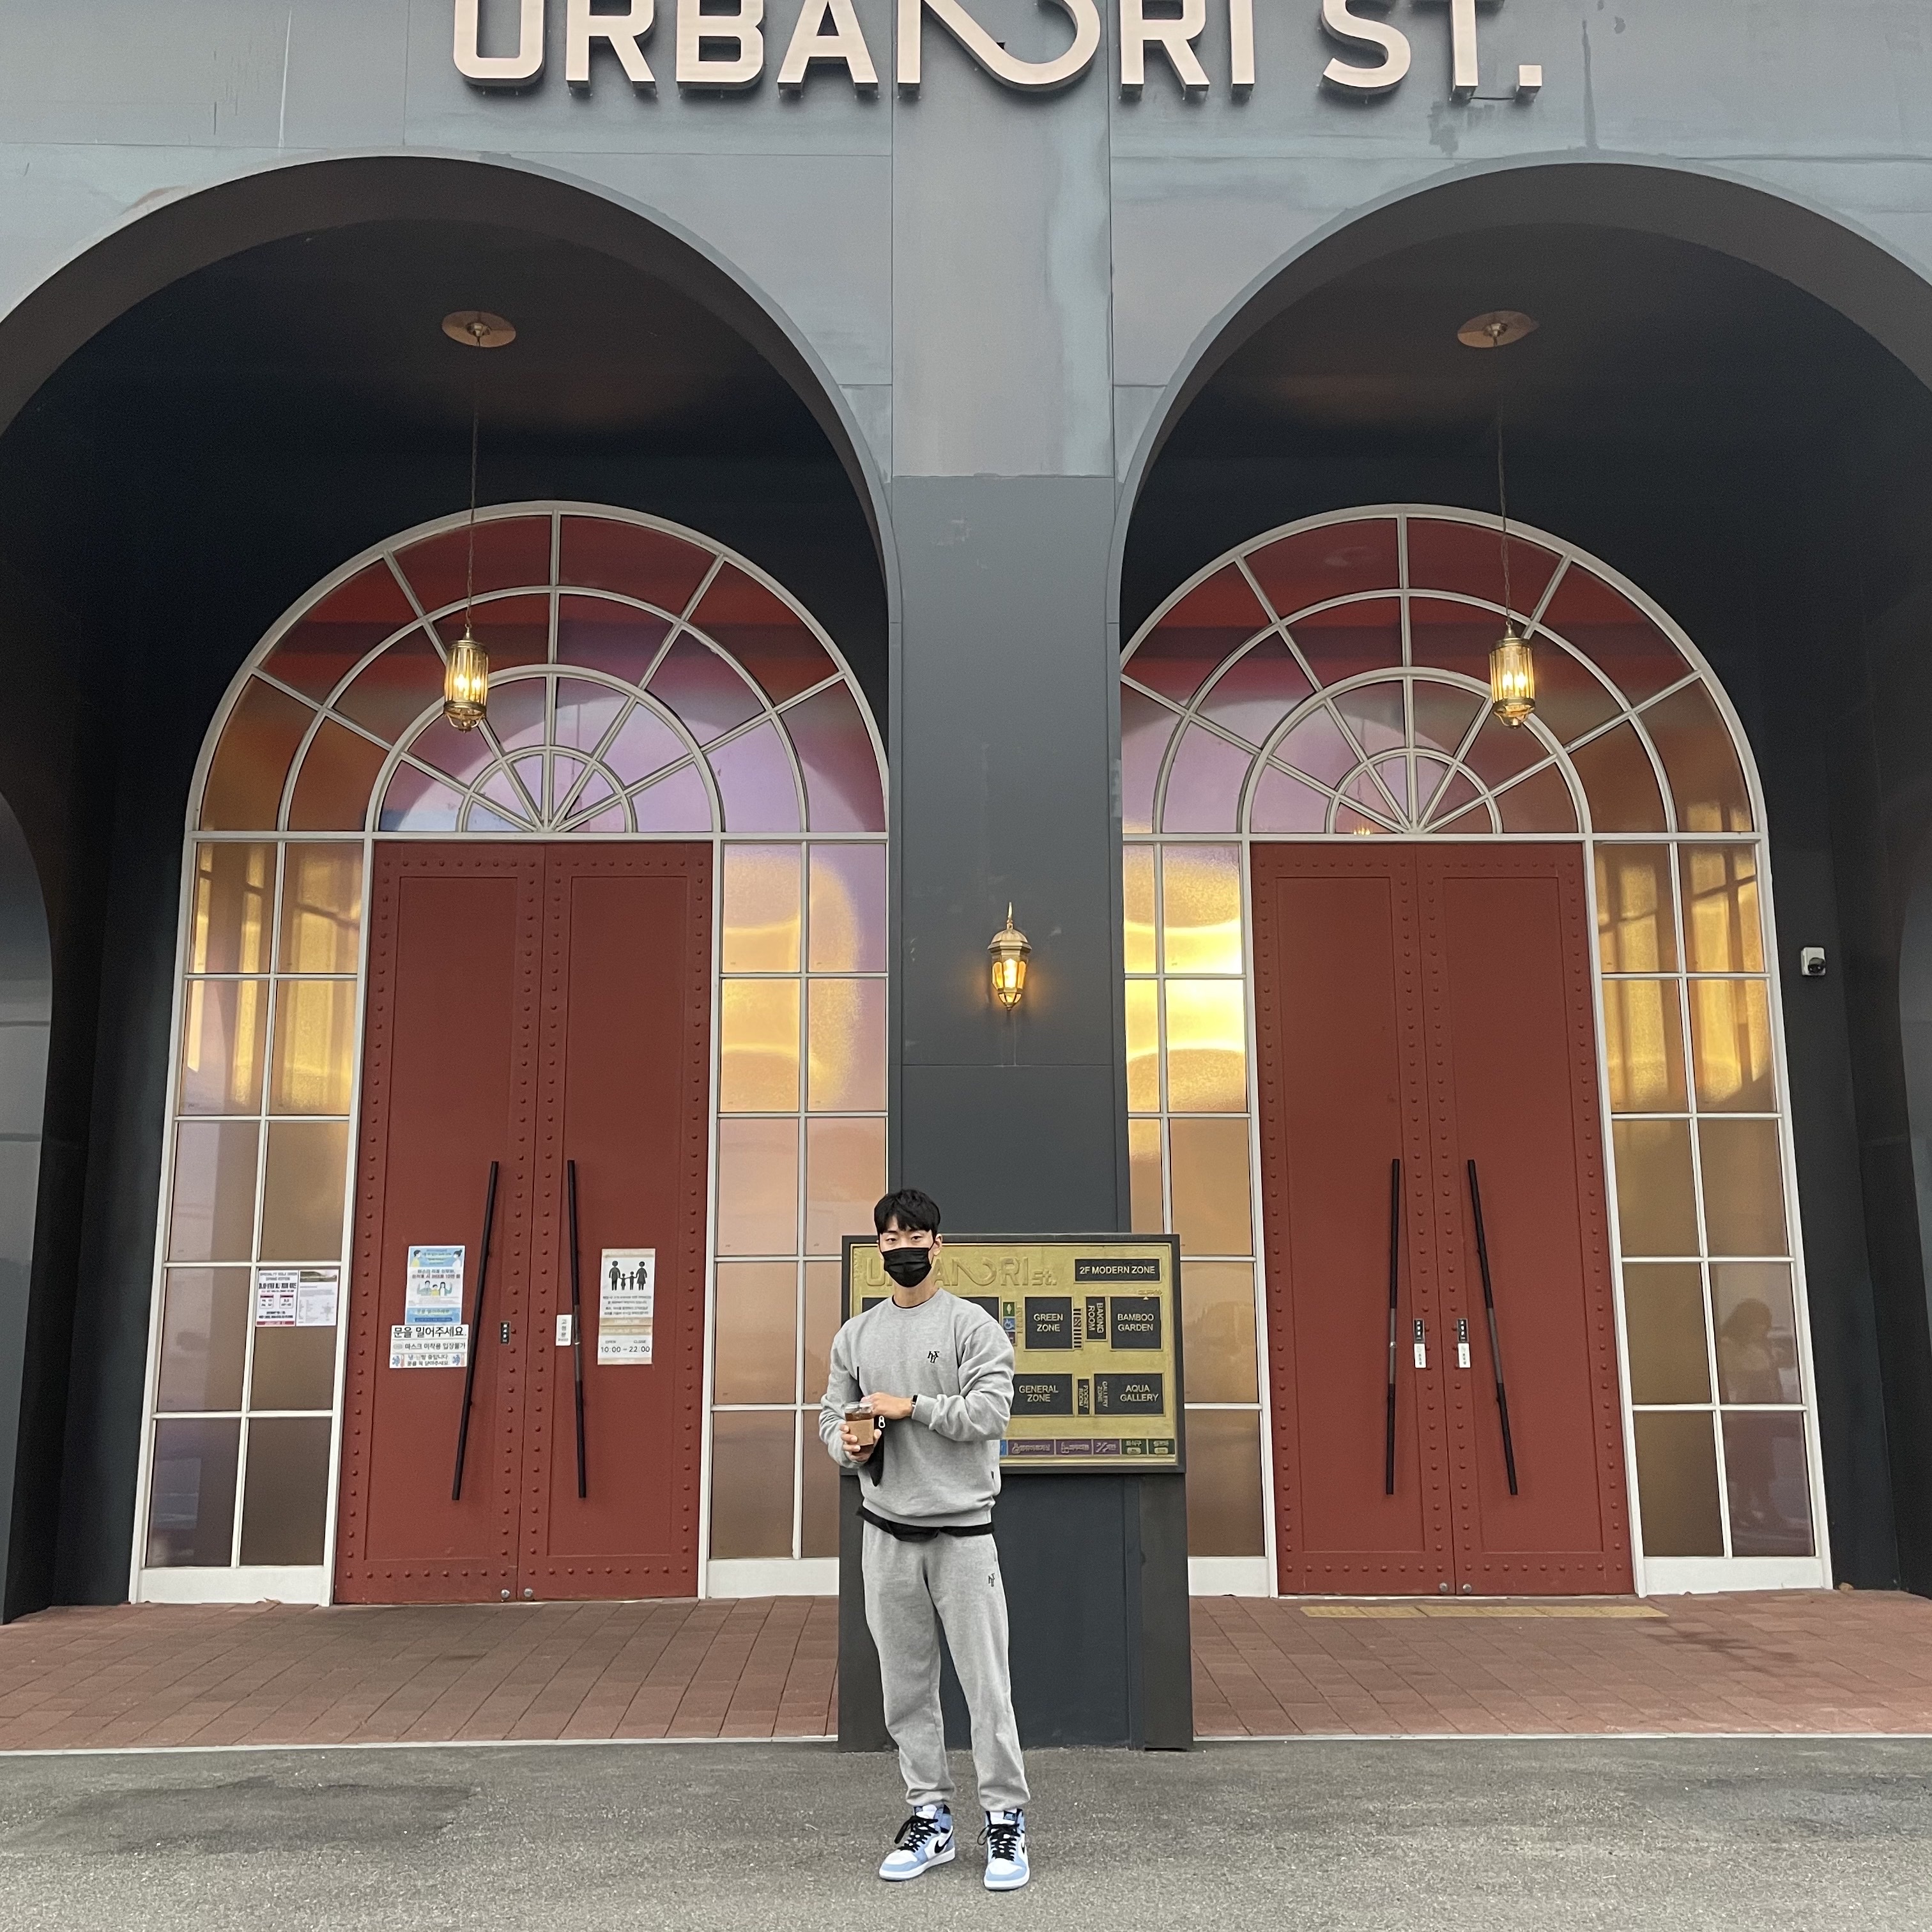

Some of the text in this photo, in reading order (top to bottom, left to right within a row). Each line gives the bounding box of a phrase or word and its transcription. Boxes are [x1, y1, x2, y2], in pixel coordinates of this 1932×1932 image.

[1322, 0, 1542, 88] ST.
[865, 1256, 1029, 1287] UANORI
[1079, 1265, 1156, 1275] 2F MODERN ZONE
[1033, 1313, 1064, 1322] GREEN
[1096, 1302, 1105, 1334] BAKING
[1117, 1314, 1154, 1322] BAMBOO
[394, 1326, 467, 1338] 문을 밀어주세요.
[1036, 1324, 1061, 1332] ZONE
[1117, 1323, 1154, 1332] GARDEN
[442, 1342, 466, 1350] 입장불가
[1018, 1385, 1059, 1393] GENERAL
[1125, 1384, 1150, 1393] AQUA
[1027, 1394, 1051, 1402] ZONE
[1119, 1393, 1159, 1402] GALLERY
